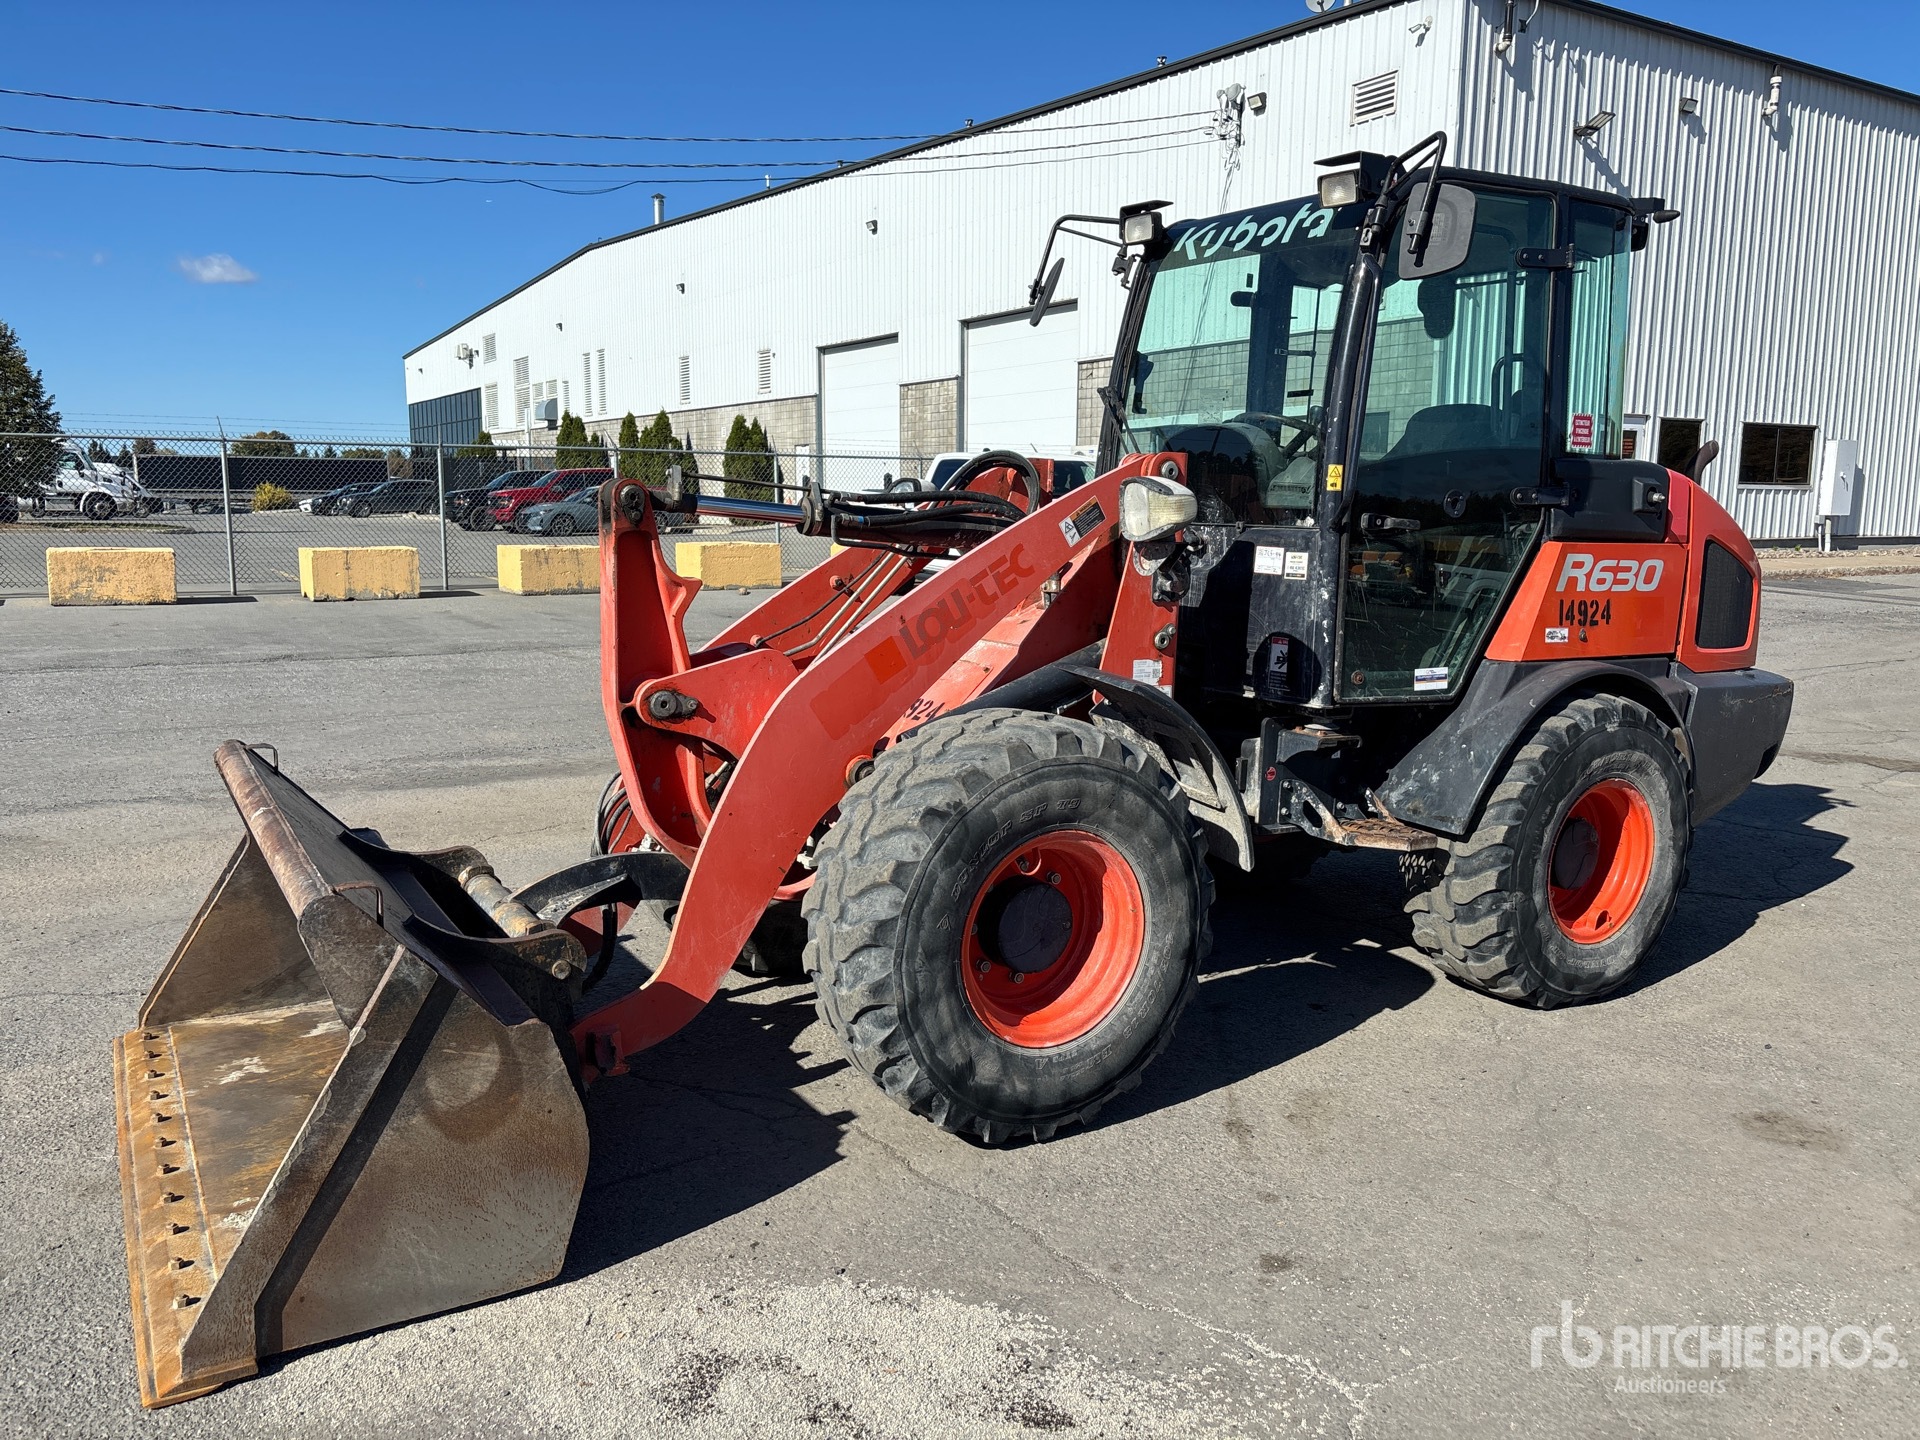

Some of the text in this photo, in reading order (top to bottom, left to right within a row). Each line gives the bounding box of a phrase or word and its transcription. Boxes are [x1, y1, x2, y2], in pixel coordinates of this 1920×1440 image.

[1173, 203, 1334, 261] Kubota
[1556, 553, 1664, 592] R630
[1559, 599, 1611, 627] 14924
[903, 698, 946, 721] 924
[951, 820, 1012, 902] DUNLOP
[1020, 802, 1048, 823] SP
